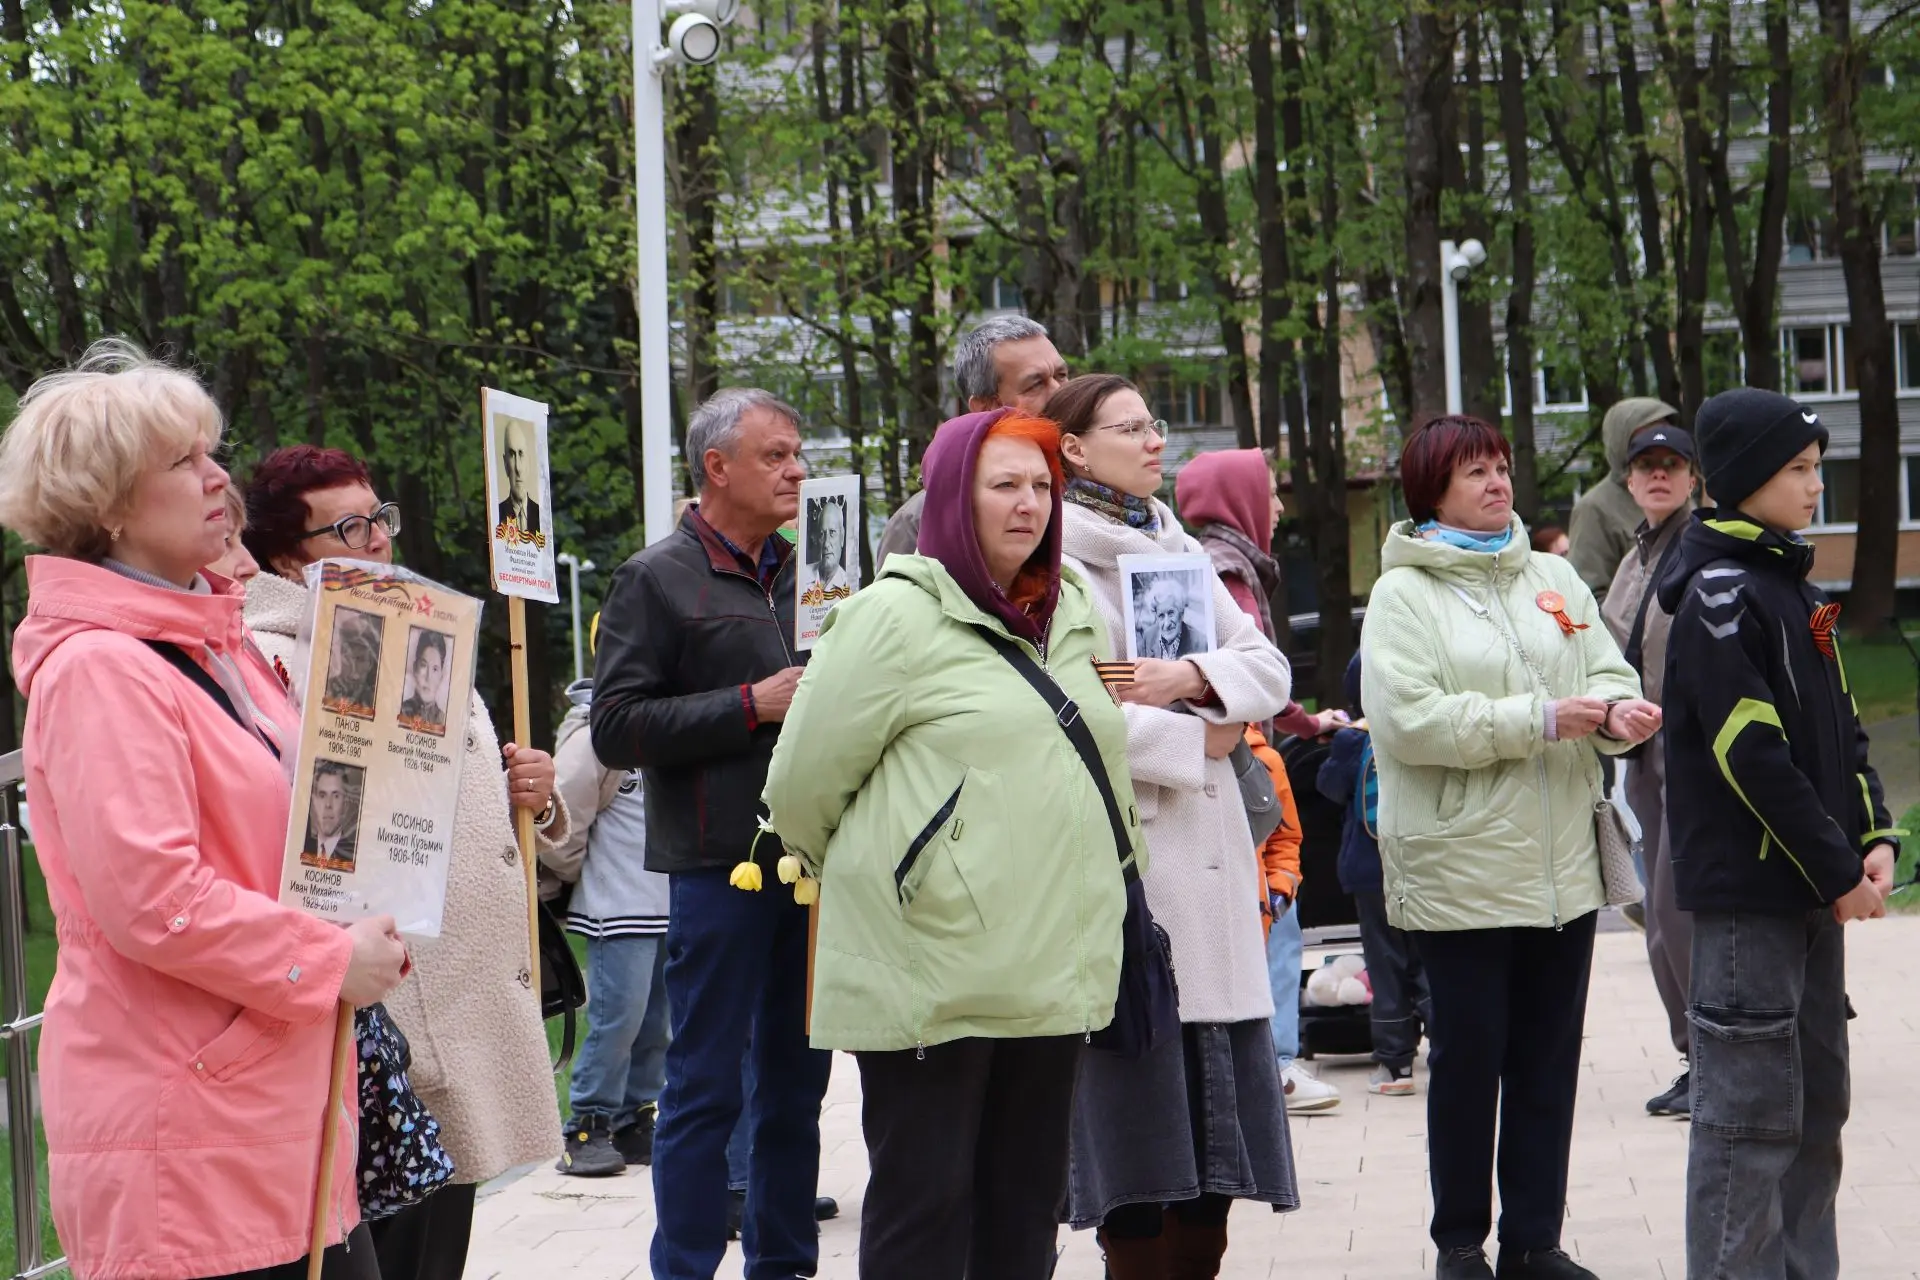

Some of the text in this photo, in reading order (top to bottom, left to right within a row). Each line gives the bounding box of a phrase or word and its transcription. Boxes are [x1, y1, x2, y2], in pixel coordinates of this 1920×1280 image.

[319, 726, 336, 739] Иван
[335, 717, 360, 732] ПАНОВ
[388, 741, 414, 756] Василий
[406, 733, 437, 749] КОСИНОВ
[391, 812, 434, 834] КОСИНОВ
[377, 826, 443, 853] Михаил Кузьмич
[389, 847, 429, 867] 1906-1941
[304, 869, 342, 886] КОСИНОВ
[290, 880, 308, 894] Иван
